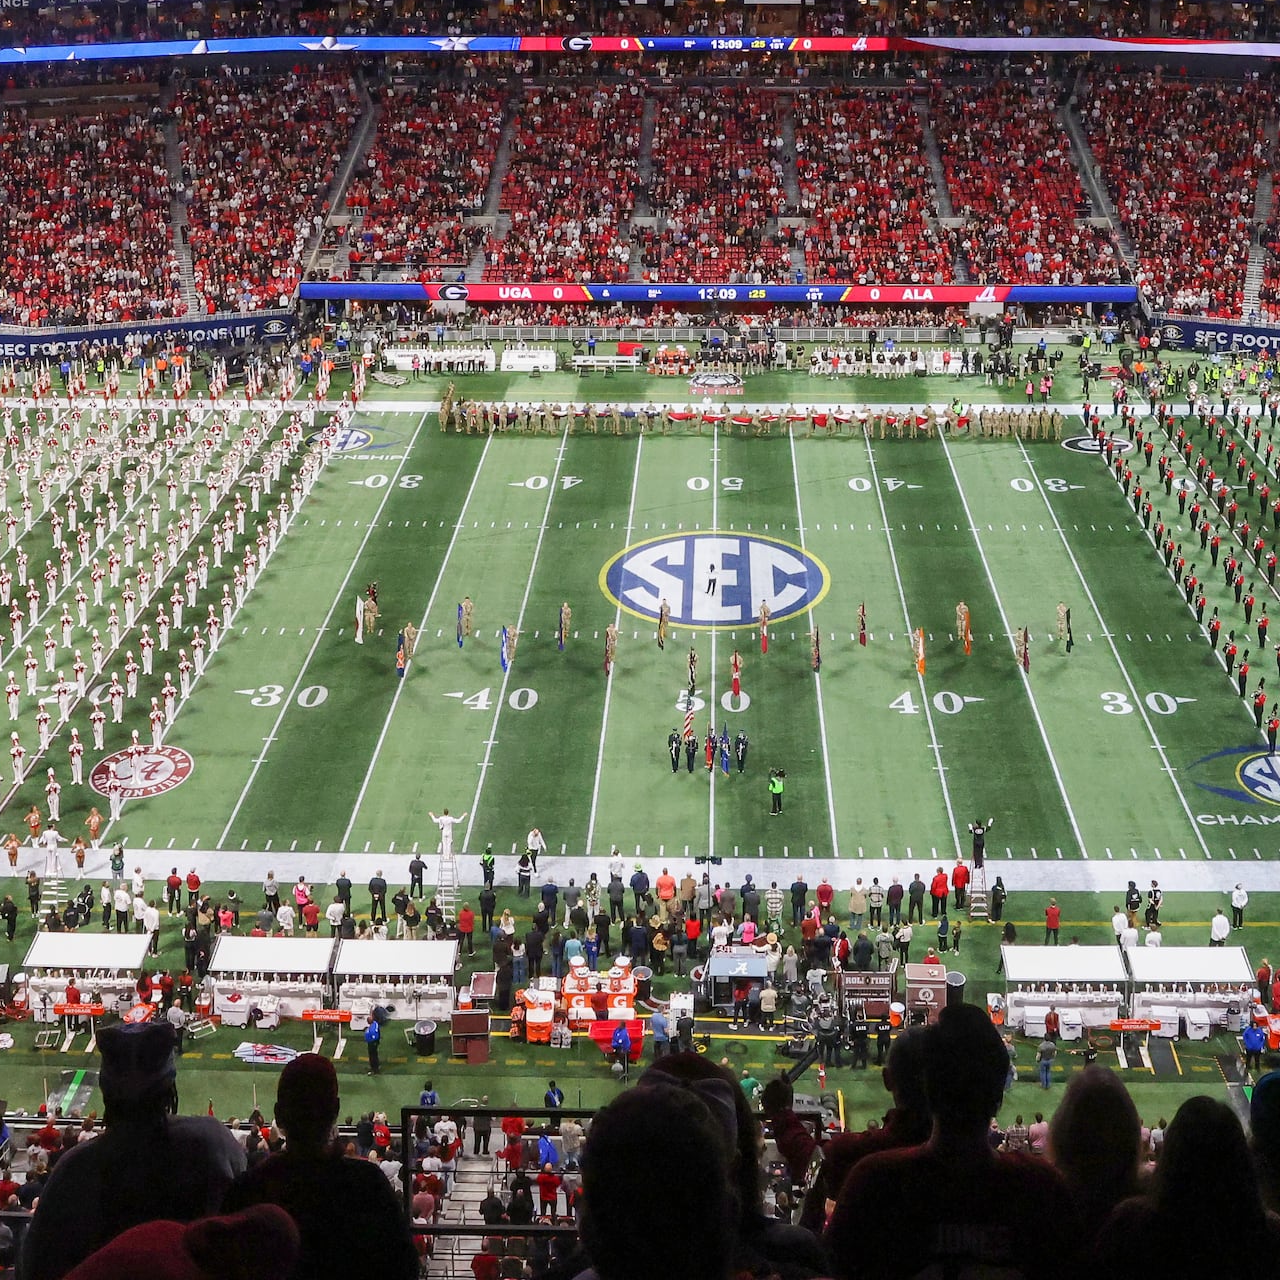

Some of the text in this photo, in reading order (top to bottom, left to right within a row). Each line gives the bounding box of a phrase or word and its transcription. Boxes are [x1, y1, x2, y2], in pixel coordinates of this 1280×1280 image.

[621, 39, 629, 49] 0
[711, 38, 743, 50] 13:09
[803, 39, 812, 49] 0
[498, 287, 532, 299] UGA
[552, 287, 563, 299] 0
[748, 289, 766, 299] :25
[805, 291, 823, 301] 1ST
[870, 288, 880, 300] 0
[902, 288, 933, 300] ALA
[620, 537, 809, 622] SEC
[249, 684, 330, 709] 30
[461, 687, 539, 712] 40
[676, 689, 752, 714] 50
[888, 691, 964, 715] 40
[1099, 692, 1178, 716] 30
[870, 976, 890, 985] TIDE
[571, 995, 585, 1009] G
[613, 995, 627, 1008] G
